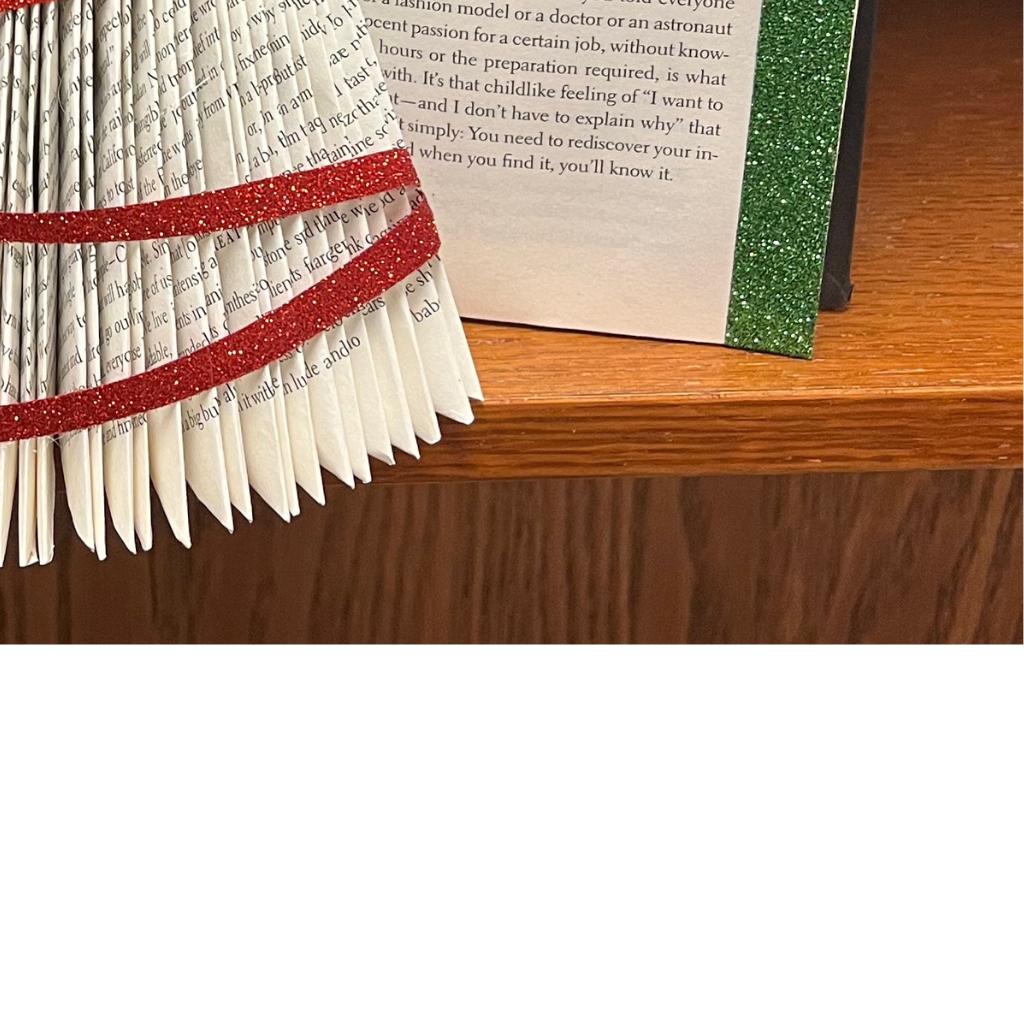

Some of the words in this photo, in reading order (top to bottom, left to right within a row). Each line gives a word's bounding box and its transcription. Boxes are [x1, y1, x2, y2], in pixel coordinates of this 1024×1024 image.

[379, 38, 423, 59] hours
[429, 52, 446, 62] or
[452, 49, 477, 66] the
[484, 58, 577, 75] preparation
[585, 64, 659, 83] required,
[667, 67, 679, 82] is
[686, 69, 727, 86] what
[419, 145, 462, 163] when
[467, 155, 496, 168] you
[502, 153, 534, 169] find
[540, 156, 554, 172] it,
[558, 159, 604, 175] you’ll
[609, 160, 654, 178] know
[659, 166, 673, 181] it.
